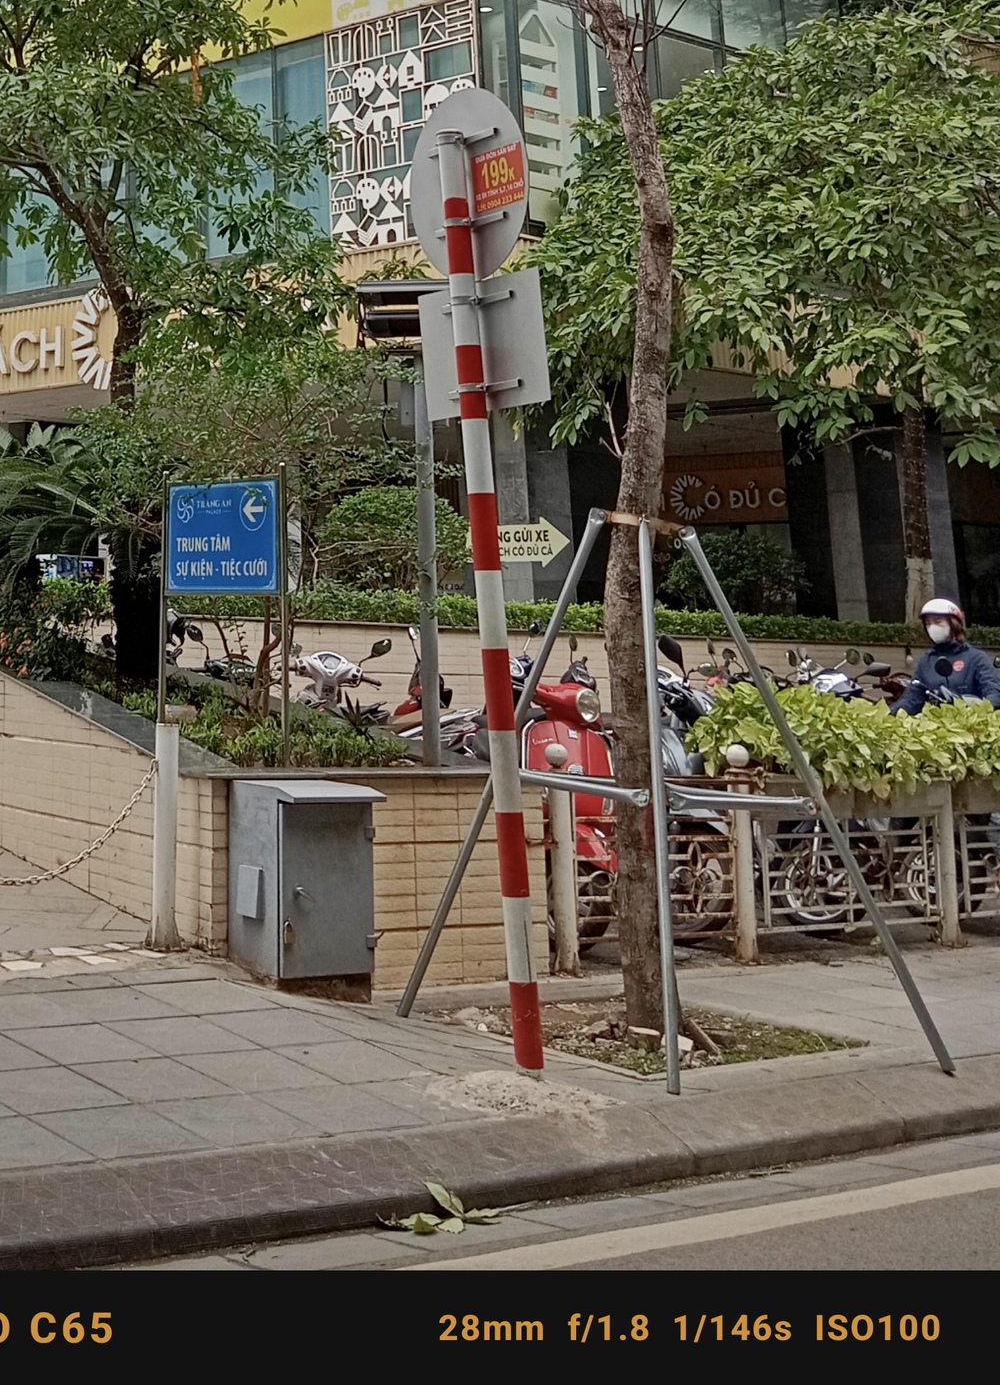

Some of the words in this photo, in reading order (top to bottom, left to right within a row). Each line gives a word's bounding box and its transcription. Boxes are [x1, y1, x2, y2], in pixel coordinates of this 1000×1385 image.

[196, 499, 220, 508] TRANG
[222, 499, 232, 507] AN
[729, 481, 760, 509] ĐỦ
[768, 487, 787, 508] C
[176, 537, 208, 552] TRUNG
[210, 534, 231, 552] TÂM
[513, 527, 532, 543] GỬI
[535, 530, 549, 542] XE
[512, 545, 525, 556] CÓ
[527, 544, 539, 556] ĐỦ
[541, 543, 553, 556] CẢ
[176, 559, 189, 580] SỰ
[190, 558, 213, 580] KIỆN
[220, 558, 242, 580] TIỆC
[243, 558, 268, 576] CƯỚI
